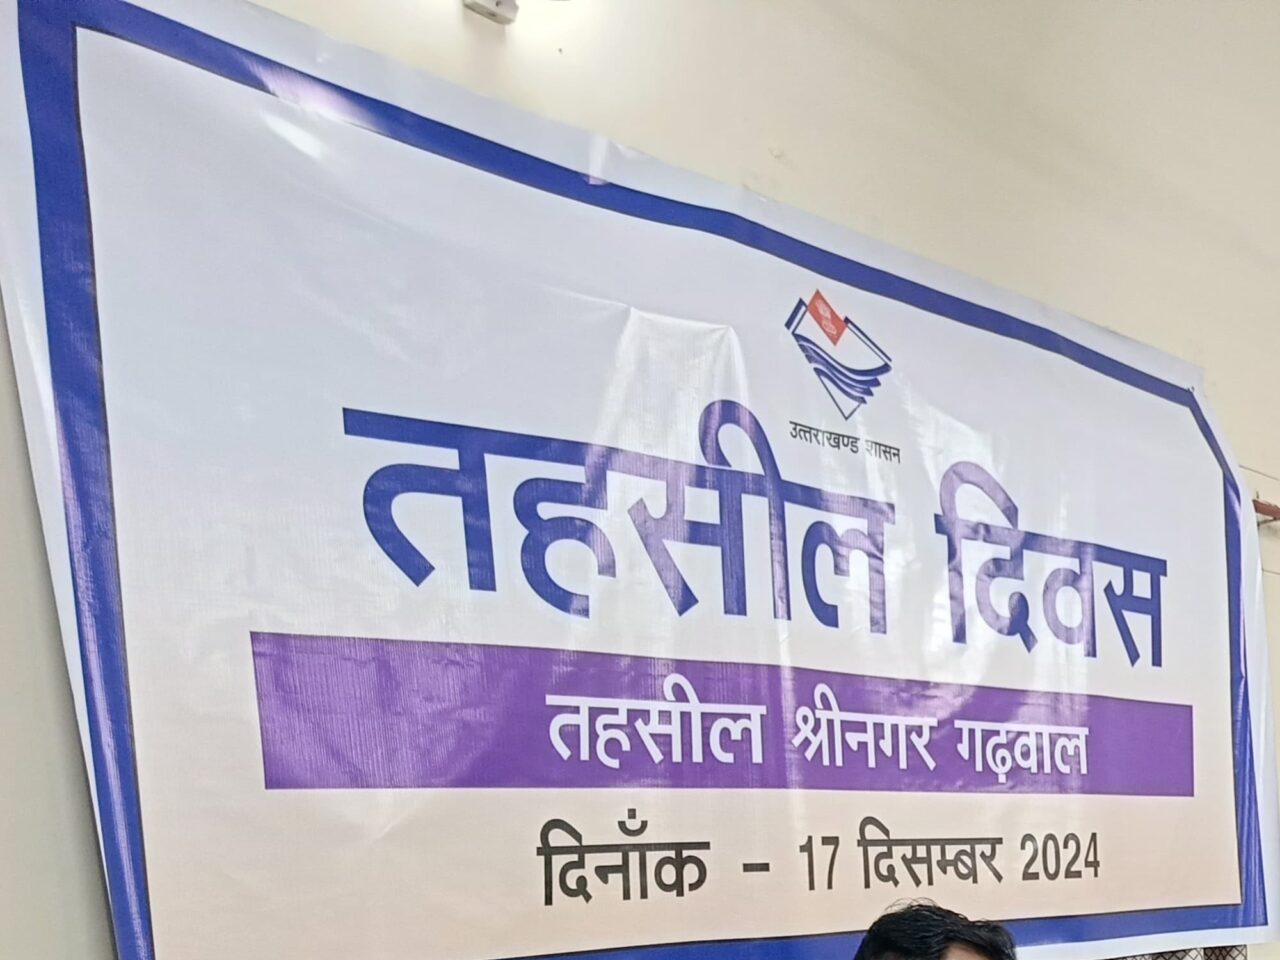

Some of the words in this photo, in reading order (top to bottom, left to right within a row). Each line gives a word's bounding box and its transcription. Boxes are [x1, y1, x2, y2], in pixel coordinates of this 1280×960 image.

[789, 421, 860, 454] उत्तराखण्ड
[865, 440, 900, 464] शासन
[342, 399, 896, 635] तहसील
[934, 461, 1168, 668] दिवस
[545, 673, 767, 769] तहसील
[791, 682, 938, 771] श्रीनगर
[954, 719, 1089, 784] गढ़वाल
[536, 808, 710, 906] दिनाँक
[799, 835, 840, 891] 17
[857, 816, 1003, 890] दिसम्बर
[1020, 832, 1101, 881] 2024
